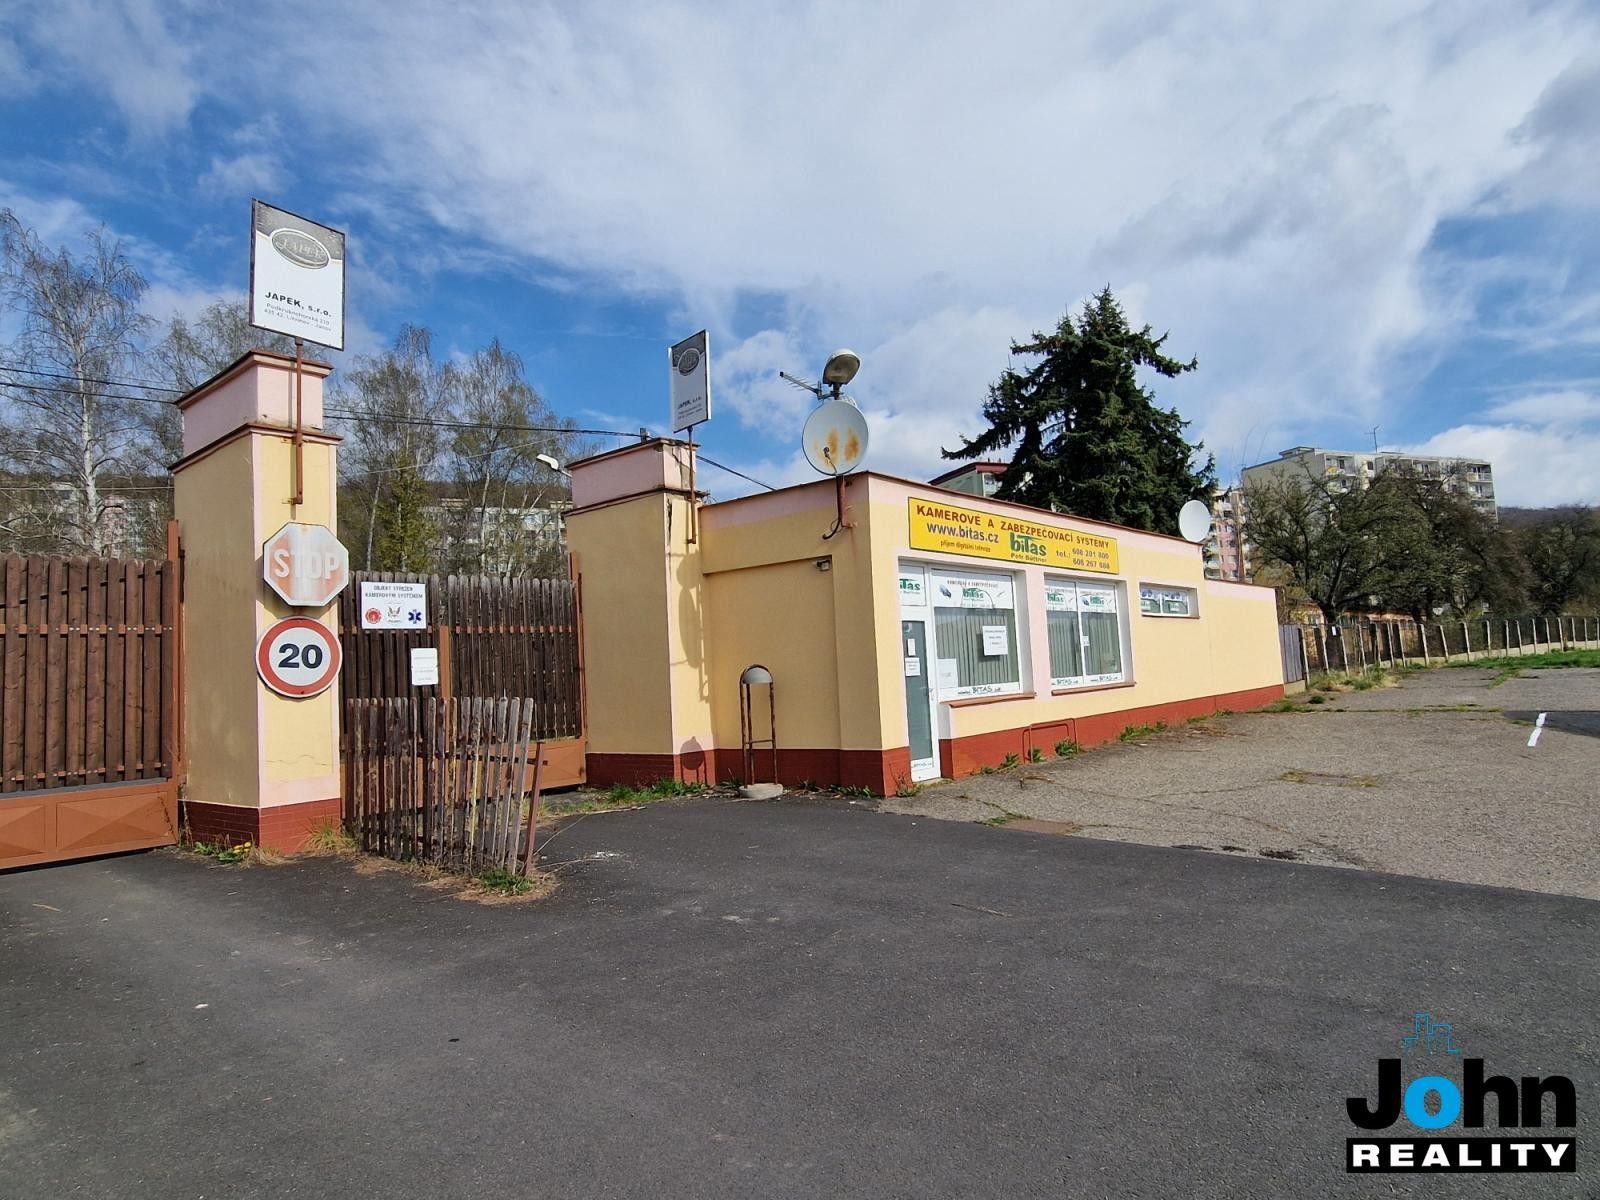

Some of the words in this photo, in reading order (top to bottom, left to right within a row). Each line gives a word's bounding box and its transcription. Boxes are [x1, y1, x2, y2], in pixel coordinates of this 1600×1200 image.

[265, 291, 304, 310] JAPEK,
[308, 305, 332, 318] s.r.o.
[916, 504, 982, 526] KAMEROVÉ
[987, 518, 995, 529] A
[1000, 521, 1073, 542] ZABEZPEČOVACÍ
[926, 522, 999, 544] www.bitas.cz
[273, 549, 340, 580] STOP
[278, 643, 323, 669] 20
